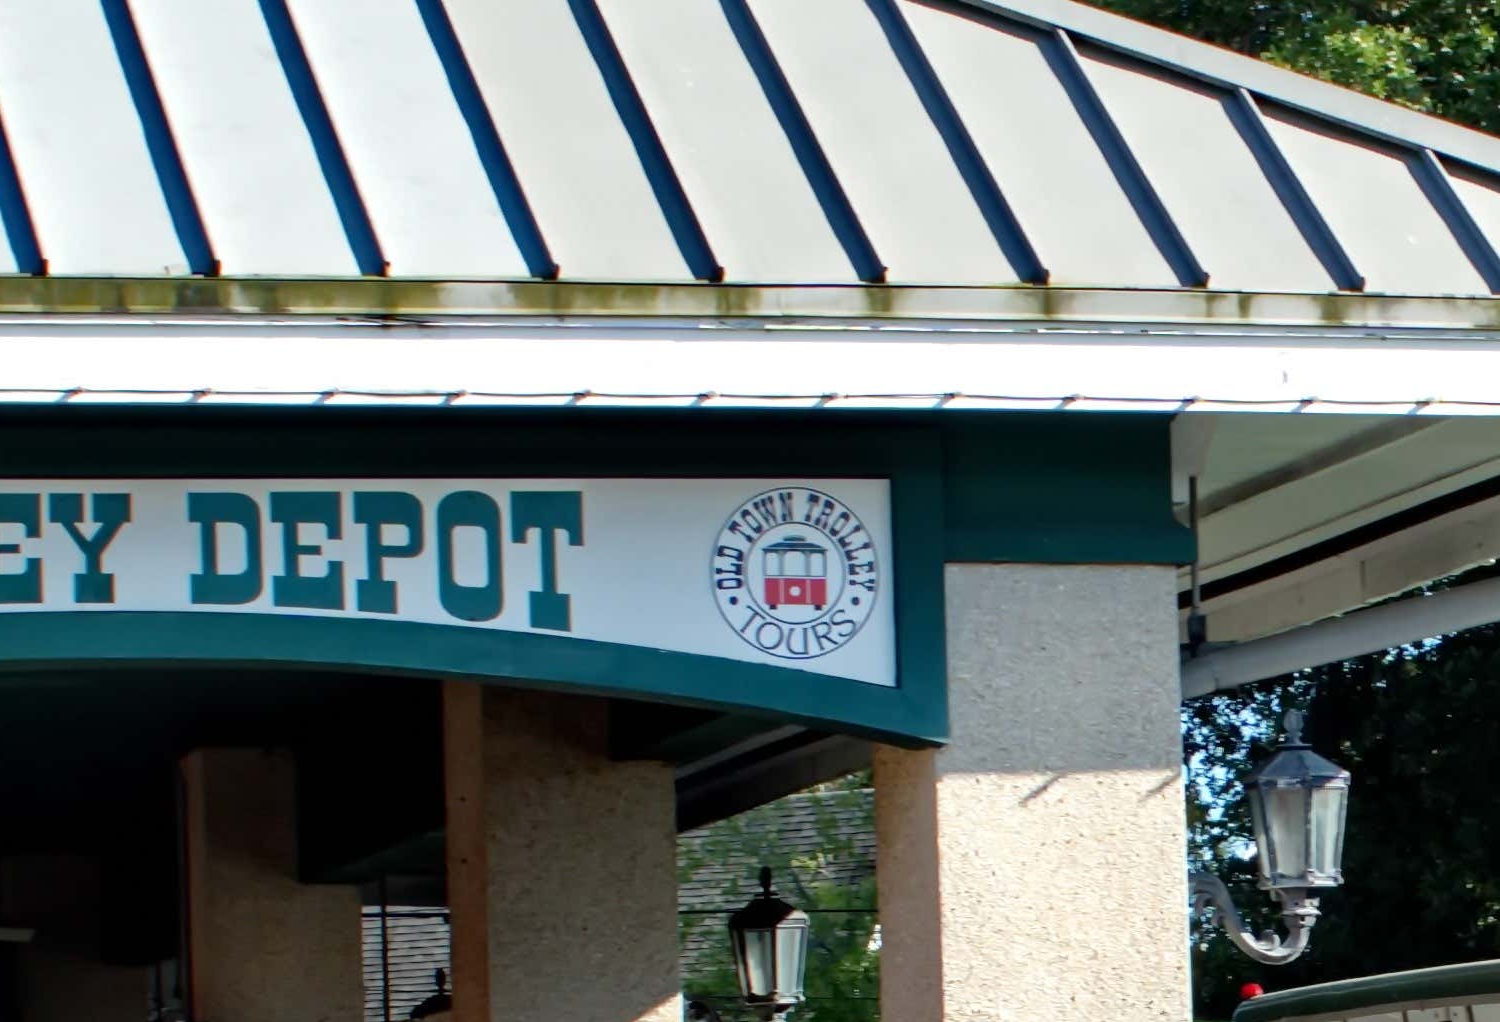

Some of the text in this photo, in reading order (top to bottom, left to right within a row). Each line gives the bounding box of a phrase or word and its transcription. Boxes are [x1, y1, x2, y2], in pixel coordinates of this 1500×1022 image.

[187, 490, 585, 632] DEPOT
[716, 492, 876, 592] OLD TOWN TROLLEY
[740, 605, 857, 655] TOURS
